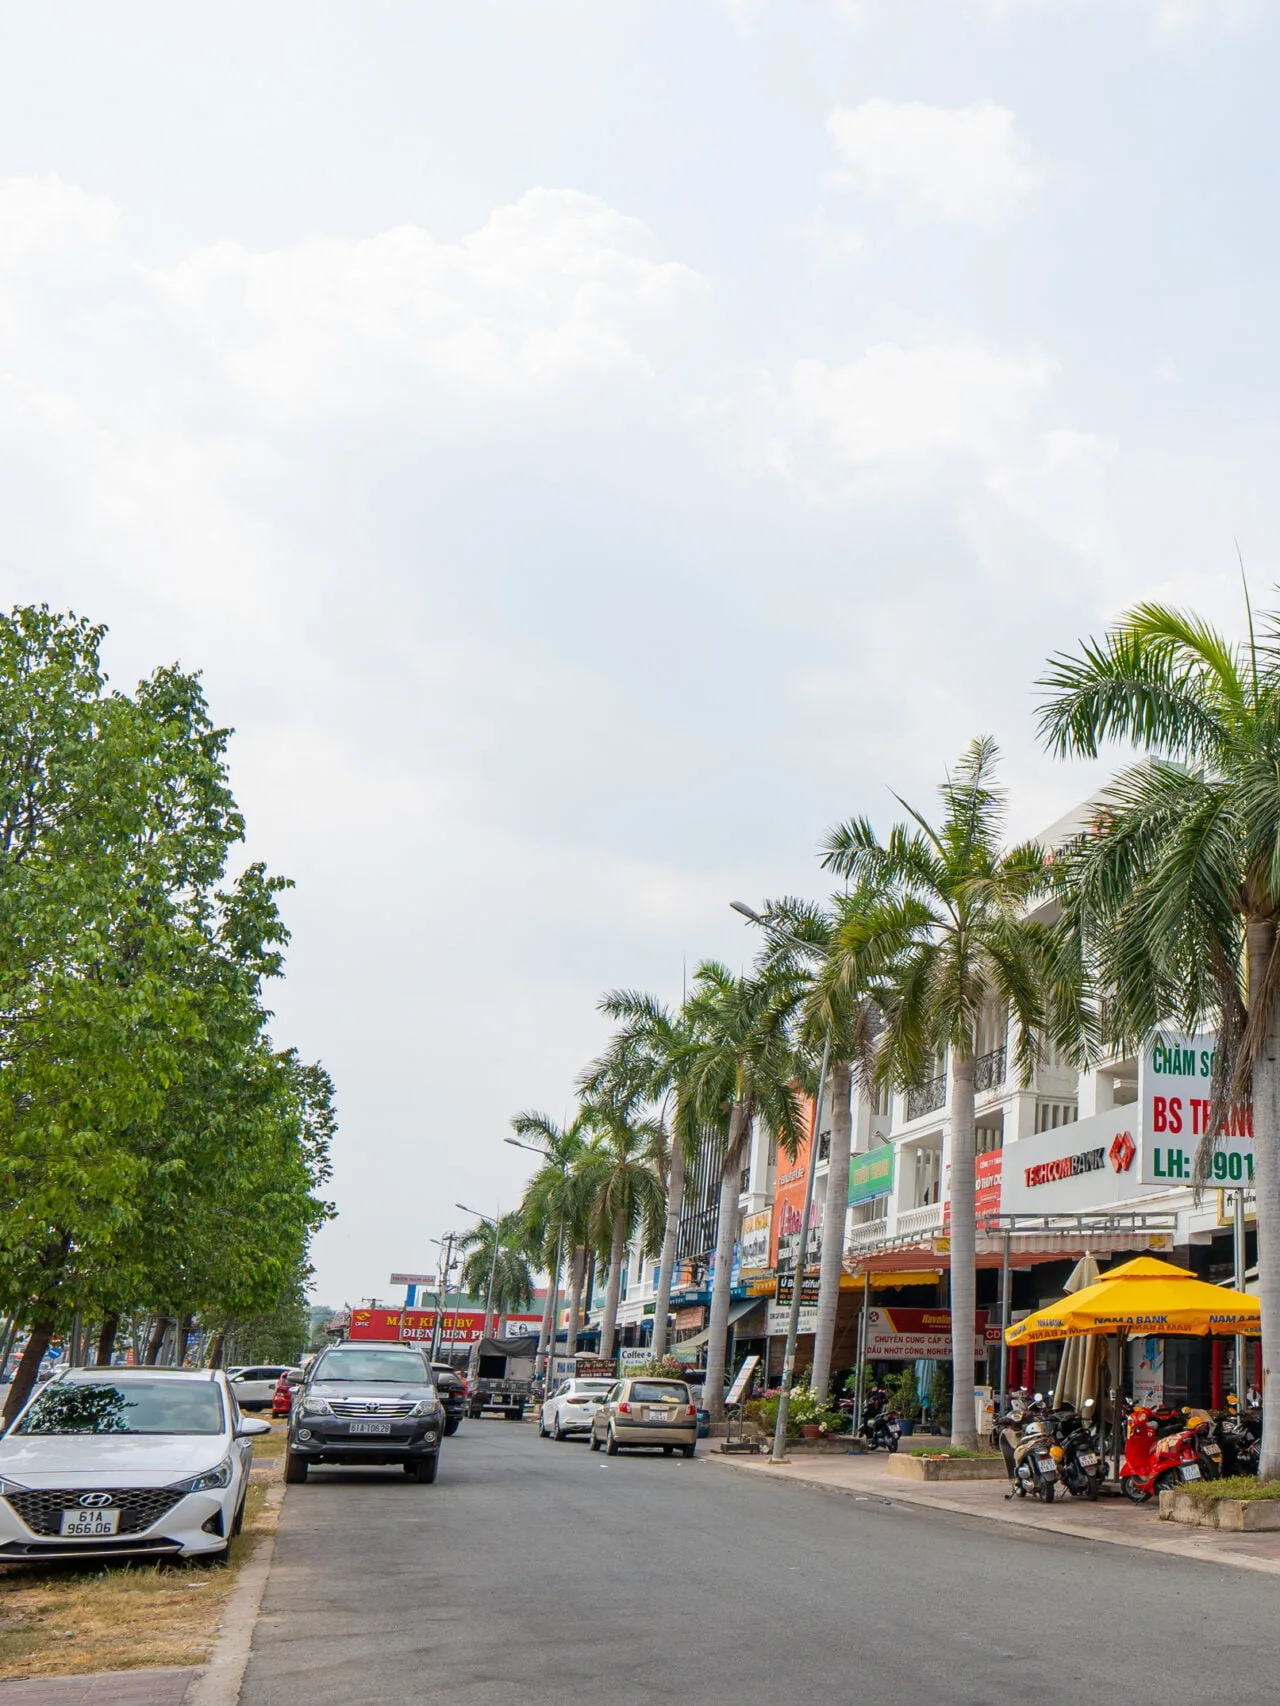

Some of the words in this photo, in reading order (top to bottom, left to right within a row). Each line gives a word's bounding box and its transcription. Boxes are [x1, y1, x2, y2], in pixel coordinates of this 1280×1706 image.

[1153, 1044, 1195, 1075] CHĂM
[1153, 1096, 1182, 1134] BS
[1024, 1147, 1105, 1187] TECHCOMBANK
[1154, 1147, 1190, 1178] LH:
[1206, 1151, 1254, 1180] 901
[420, 1314, 452, 1327] KÍH
[1136, 1315, 1168, 1324] BANK
[1209, 1315, 1236, 1323] NAM
[875, 1334, 904, 1343] CHUYÊN
[928, 1335, 941, 1344] CẤP
[622, 1350, 645, 1360] Coffee
[905, 1346, 923, 1355] CÔNG
[79, 1511, 103, 1522] 61A
[67, 1523, 111, 1534] 966.06
